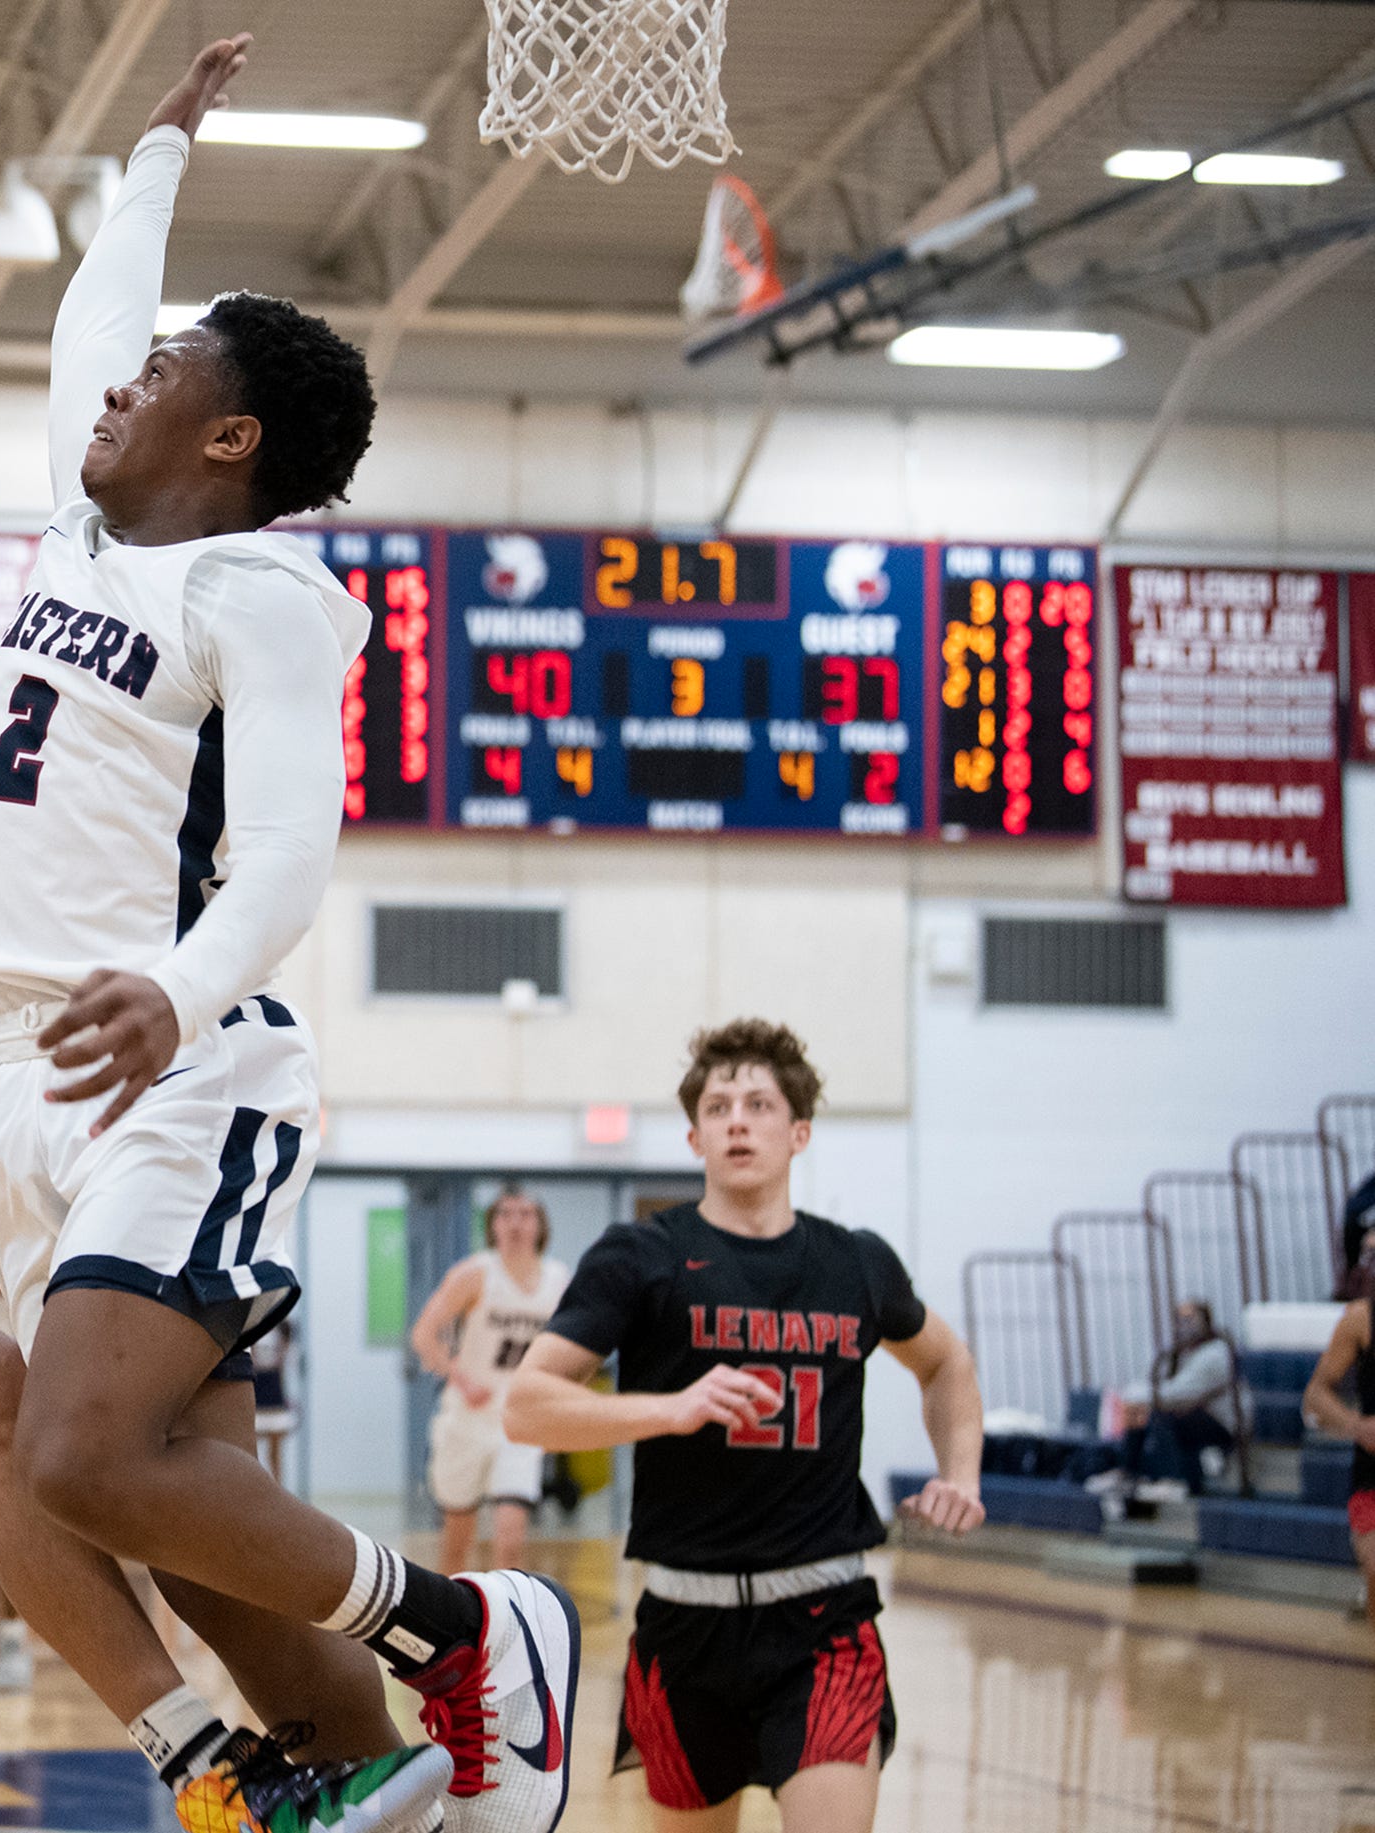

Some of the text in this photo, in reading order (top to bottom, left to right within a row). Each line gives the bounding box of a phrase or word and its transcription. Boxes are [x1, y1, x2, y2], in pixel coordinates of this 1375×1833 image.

[596, 538, 737, 607] 21.7
[0, 591, 160, 700] ASTERN
[465, 607, 585, 650] VIKINGS
[802, 612, 900, 655] GUEST
[488, 651, 572, 719] 40
[671, 658, 704, 716] 3
[822, 657, 899, 725] 37
[485, 747, 522, 795] 4
[557, 747, 593, 797] 4
[779, 751, 815, 801] 4
[864, 751, 899, 805] 2
[690, 1304, 861, 1359] LENAPE
[727, 1363, 823, 1449] 21
